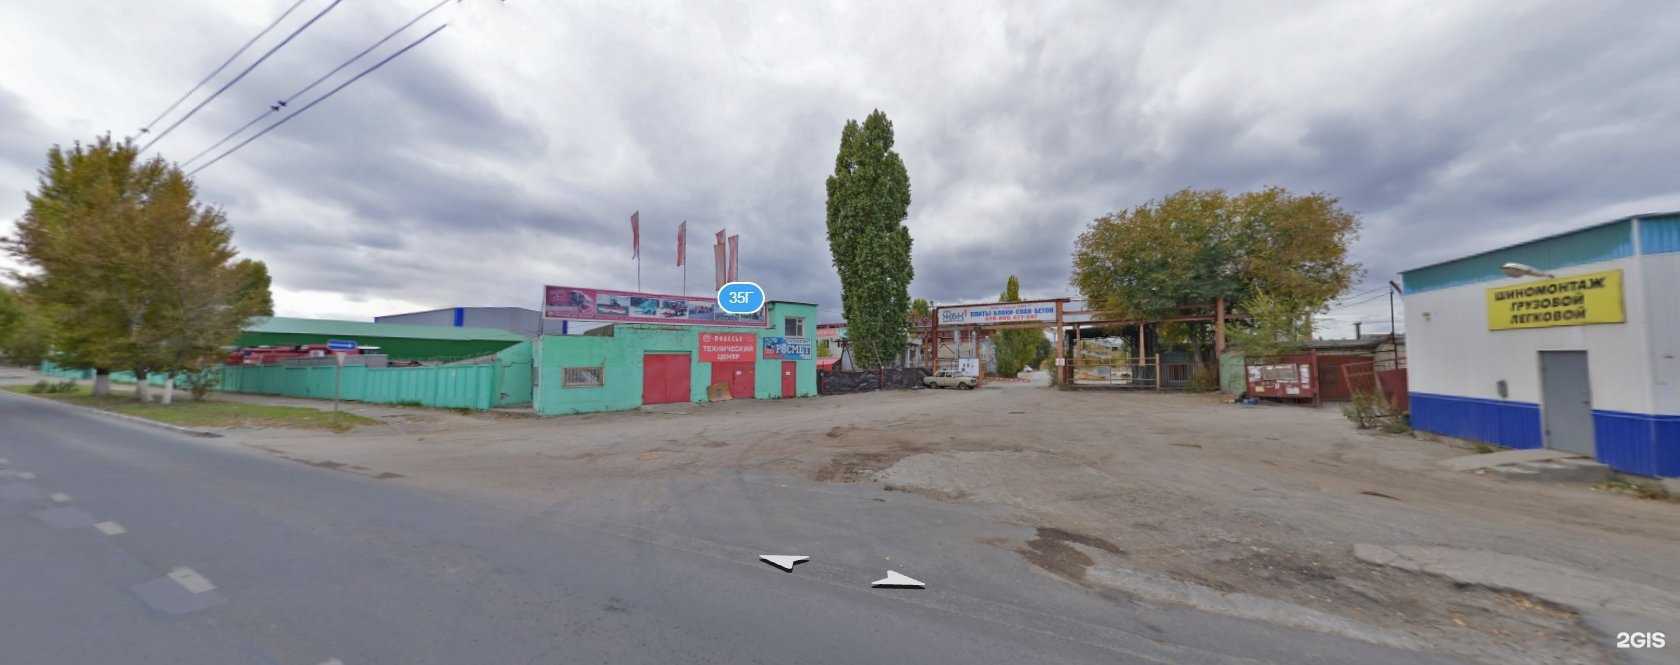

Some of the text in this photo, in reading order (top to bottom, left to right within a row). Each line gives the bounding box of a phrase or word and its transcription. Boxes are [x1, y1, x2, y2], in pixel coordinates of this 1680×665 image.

[1494, 276, 1606, 301] ШИНОМОНТАЖ
[1510, 292, 1585, 311] ГРУЗОВОЙ
[1510, 307, 1586, 324] ЛЕГКОВОЙ
[703, 345, 753, 353] ТЕХНИЧЕСКИЙ
